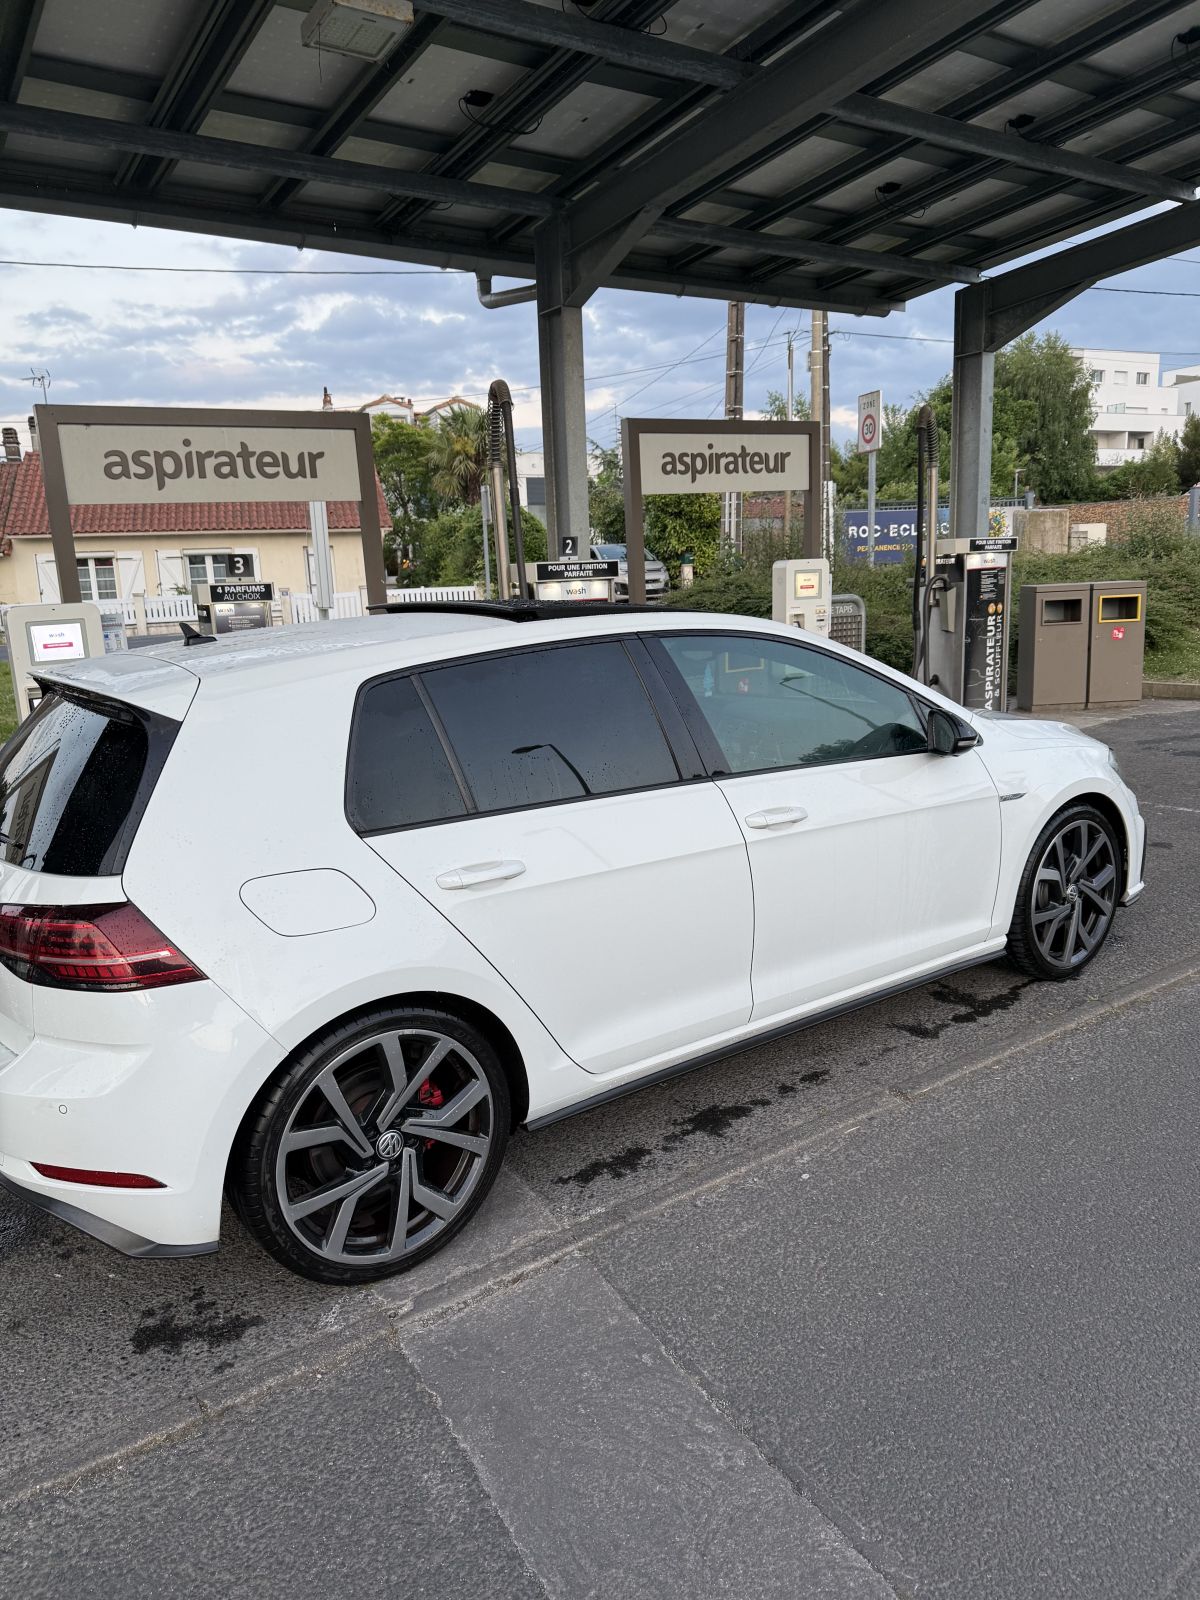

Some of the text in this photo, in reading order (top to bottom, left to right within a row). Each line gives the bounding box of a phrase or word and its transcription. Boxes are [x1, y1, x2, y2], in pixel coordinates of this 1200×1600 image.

[862, 400, 876, 410] ZONE
[865, 423, 873, 435] 30
[103, 438, 325, 491] aspirateur
[661, 443, 791, 483] aspirateur
[565, 539, 573, 554] 2
[234, 557, 244, 574] 3
[225, 585, 265, 593] PARFUMS
[566, 587, 587, 595] wash
[836, 605, 853, 614] TAPIS
[994, 614, 1002, 685] SOUFFLEUR
[984, 615, 996, 710] ASPIRATEUR
